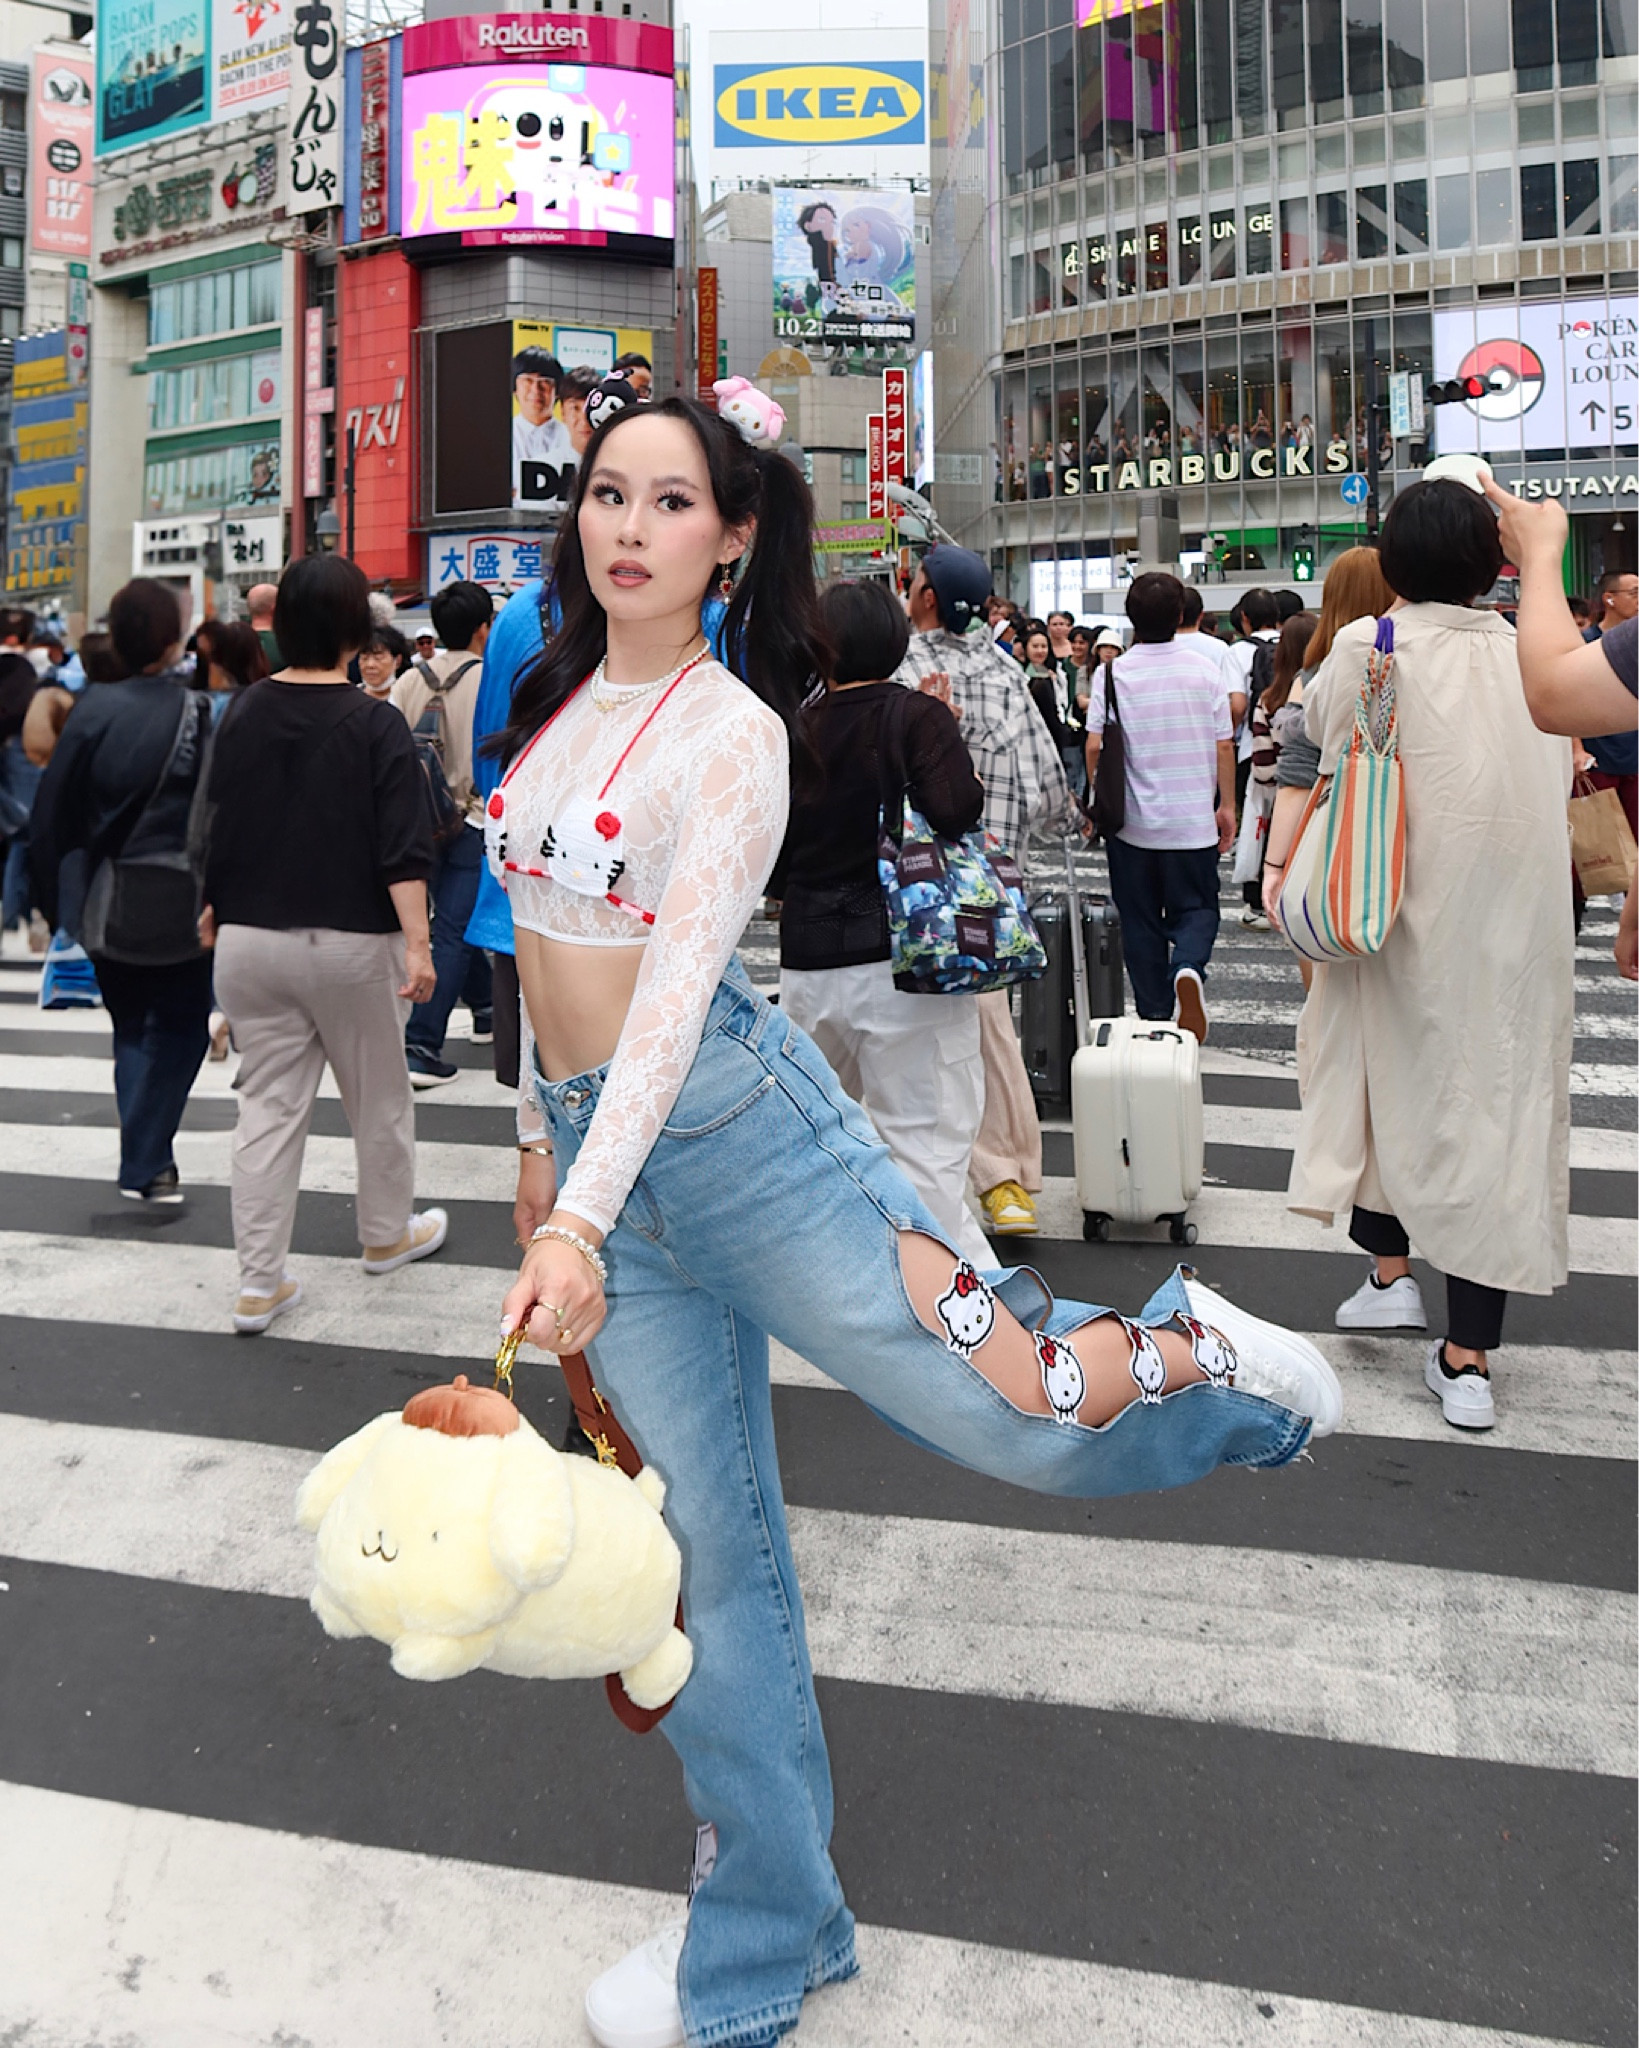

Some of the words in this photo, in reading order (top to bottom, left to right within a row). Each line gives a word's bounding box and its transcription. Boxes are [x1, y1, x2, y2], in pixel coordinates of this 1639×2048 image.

[478, 21, 588, 49] Rakuten
[292, 0, 338, 201] もんじゃ
[737, 86, 907, 120] IKEA
[701, 272, 714, 378] クスリのことなら
[346, 376, 406, 449] クスリ
[1064, 442, 1350, 495] STARBUCKS
[1509, 474, 1638, 499] TSUTAYA
[440, 543, 542, 583] 大盛堂
